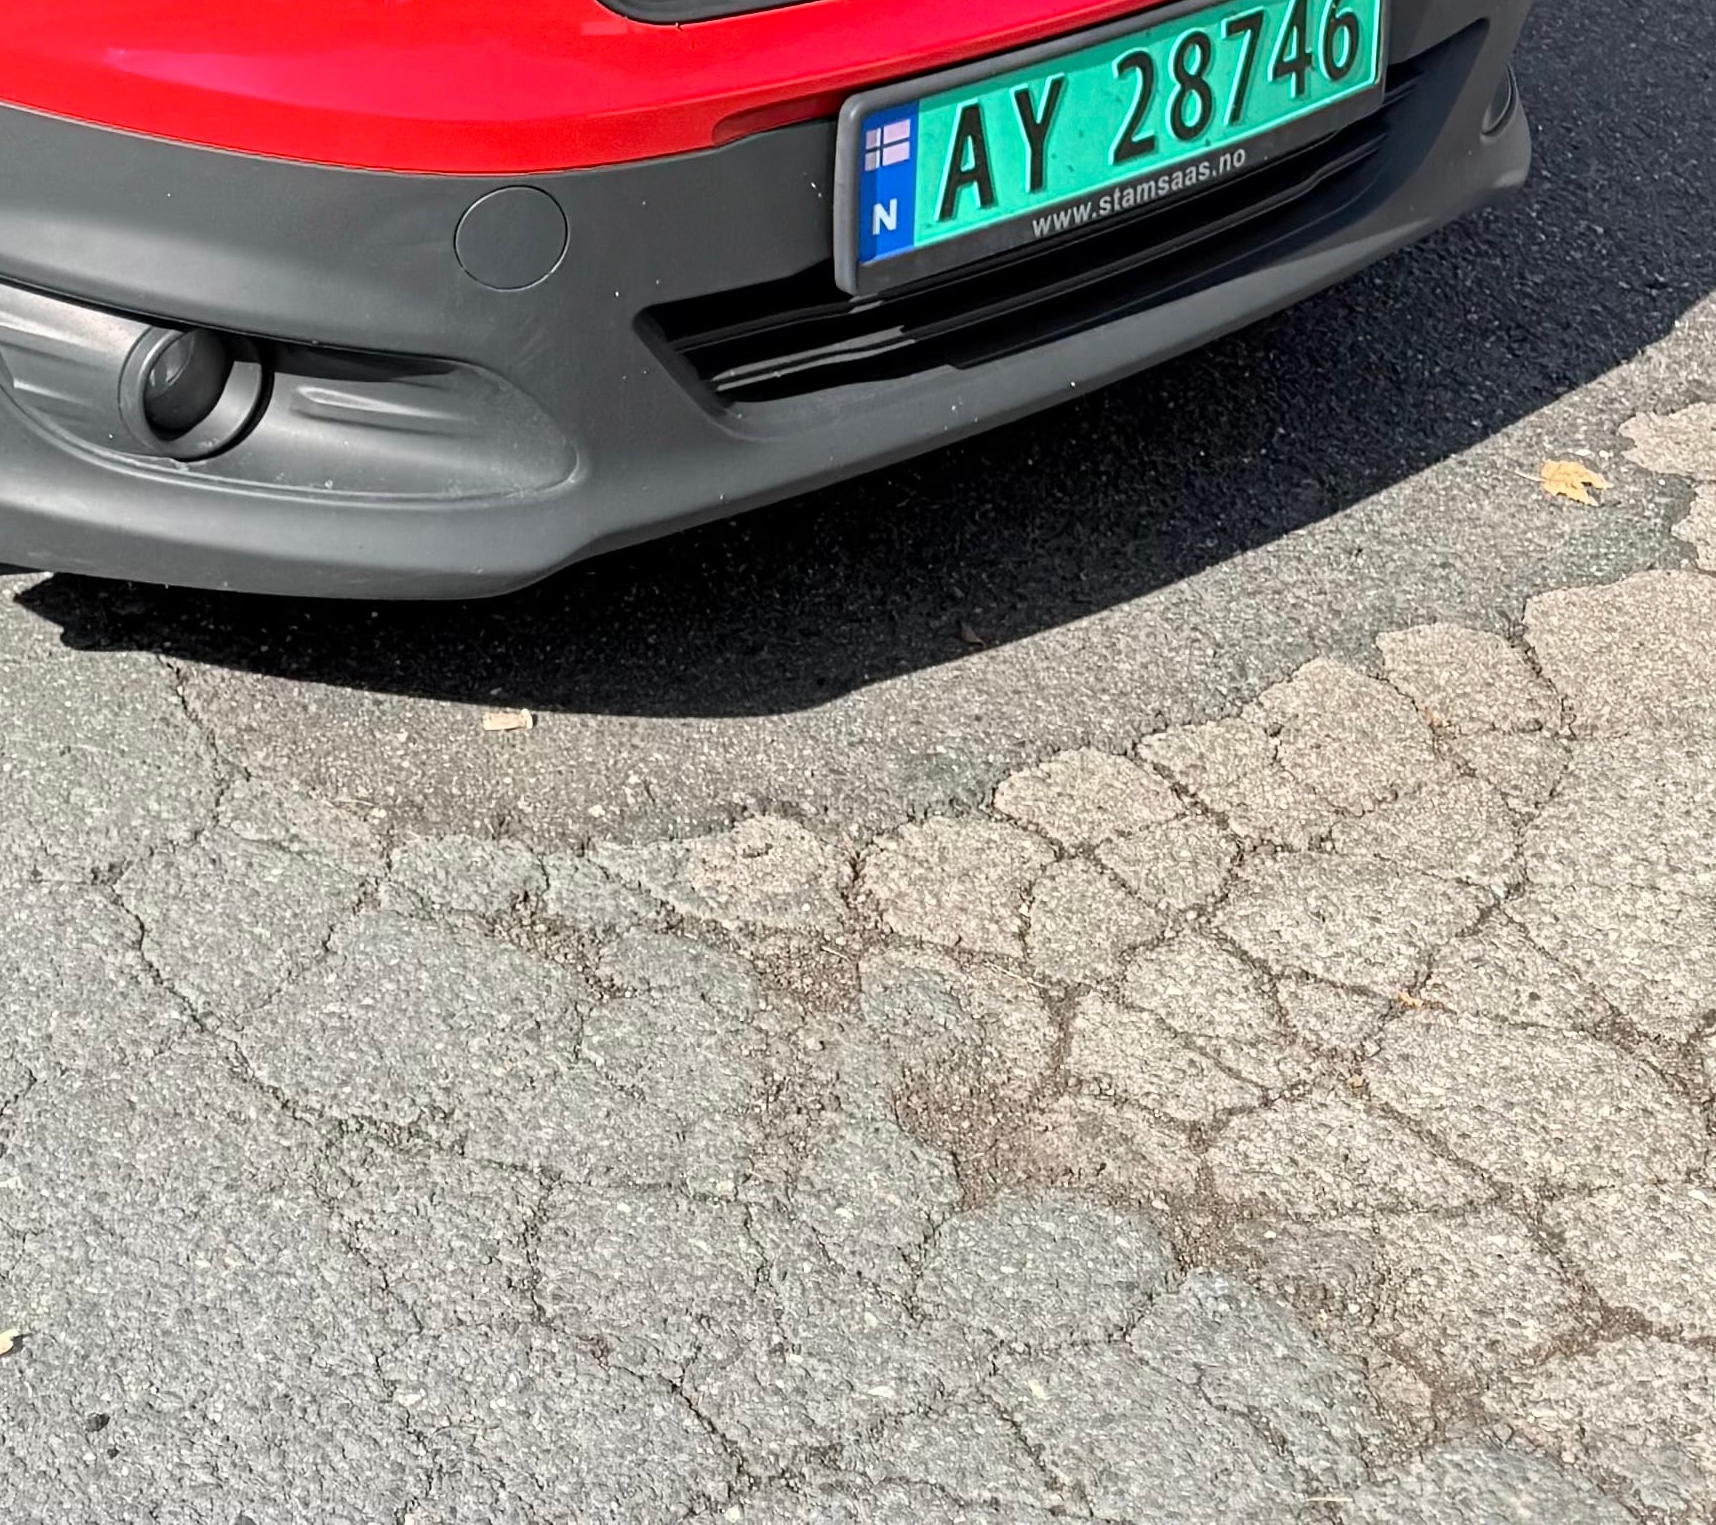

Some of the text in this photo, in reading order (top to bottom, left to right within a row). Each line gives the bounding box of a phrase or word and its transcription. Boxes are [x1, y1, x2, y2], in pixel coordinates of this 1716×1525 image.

[935, 72, 1068, 222] AY
[872, 198, 897, 236] N
[1032, 148, 1246, 238] www.stamsaas.no
